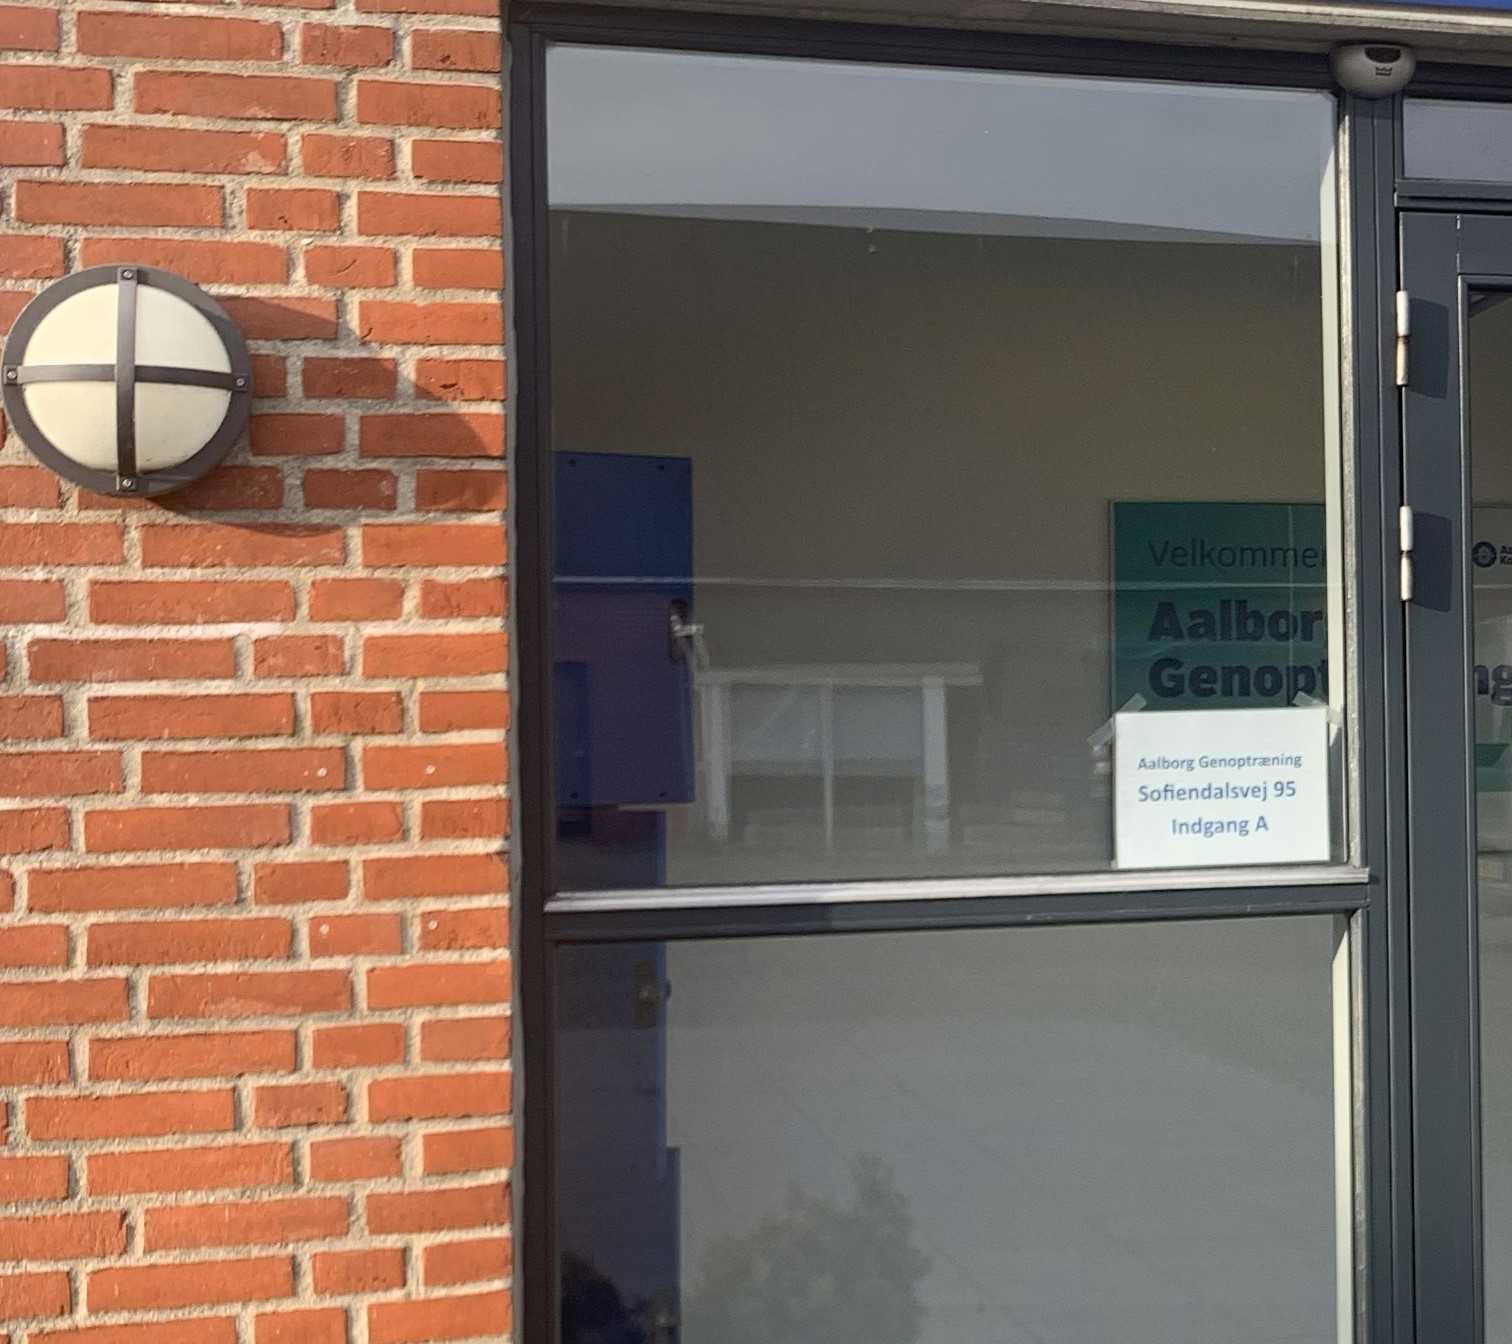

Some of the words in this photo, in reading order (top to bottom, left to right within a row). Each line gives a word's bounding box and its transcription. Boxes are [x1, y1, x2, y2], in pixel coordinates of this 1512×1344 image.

[1148, 540, 1327, 569] Velkomme
[1149, 600, 1324, 642] Aalbor
[1138, 757, 1195, 772] Aalborg
[1198, 754, 1303, 769] Genoptræning
[1138, 781, 1268, 802] Sofiendalsvej
[1273, 780, 1297, 798] 95
[1171, 816, 1250, 838] Indgang
[1255, 815, 1269, 832] A
